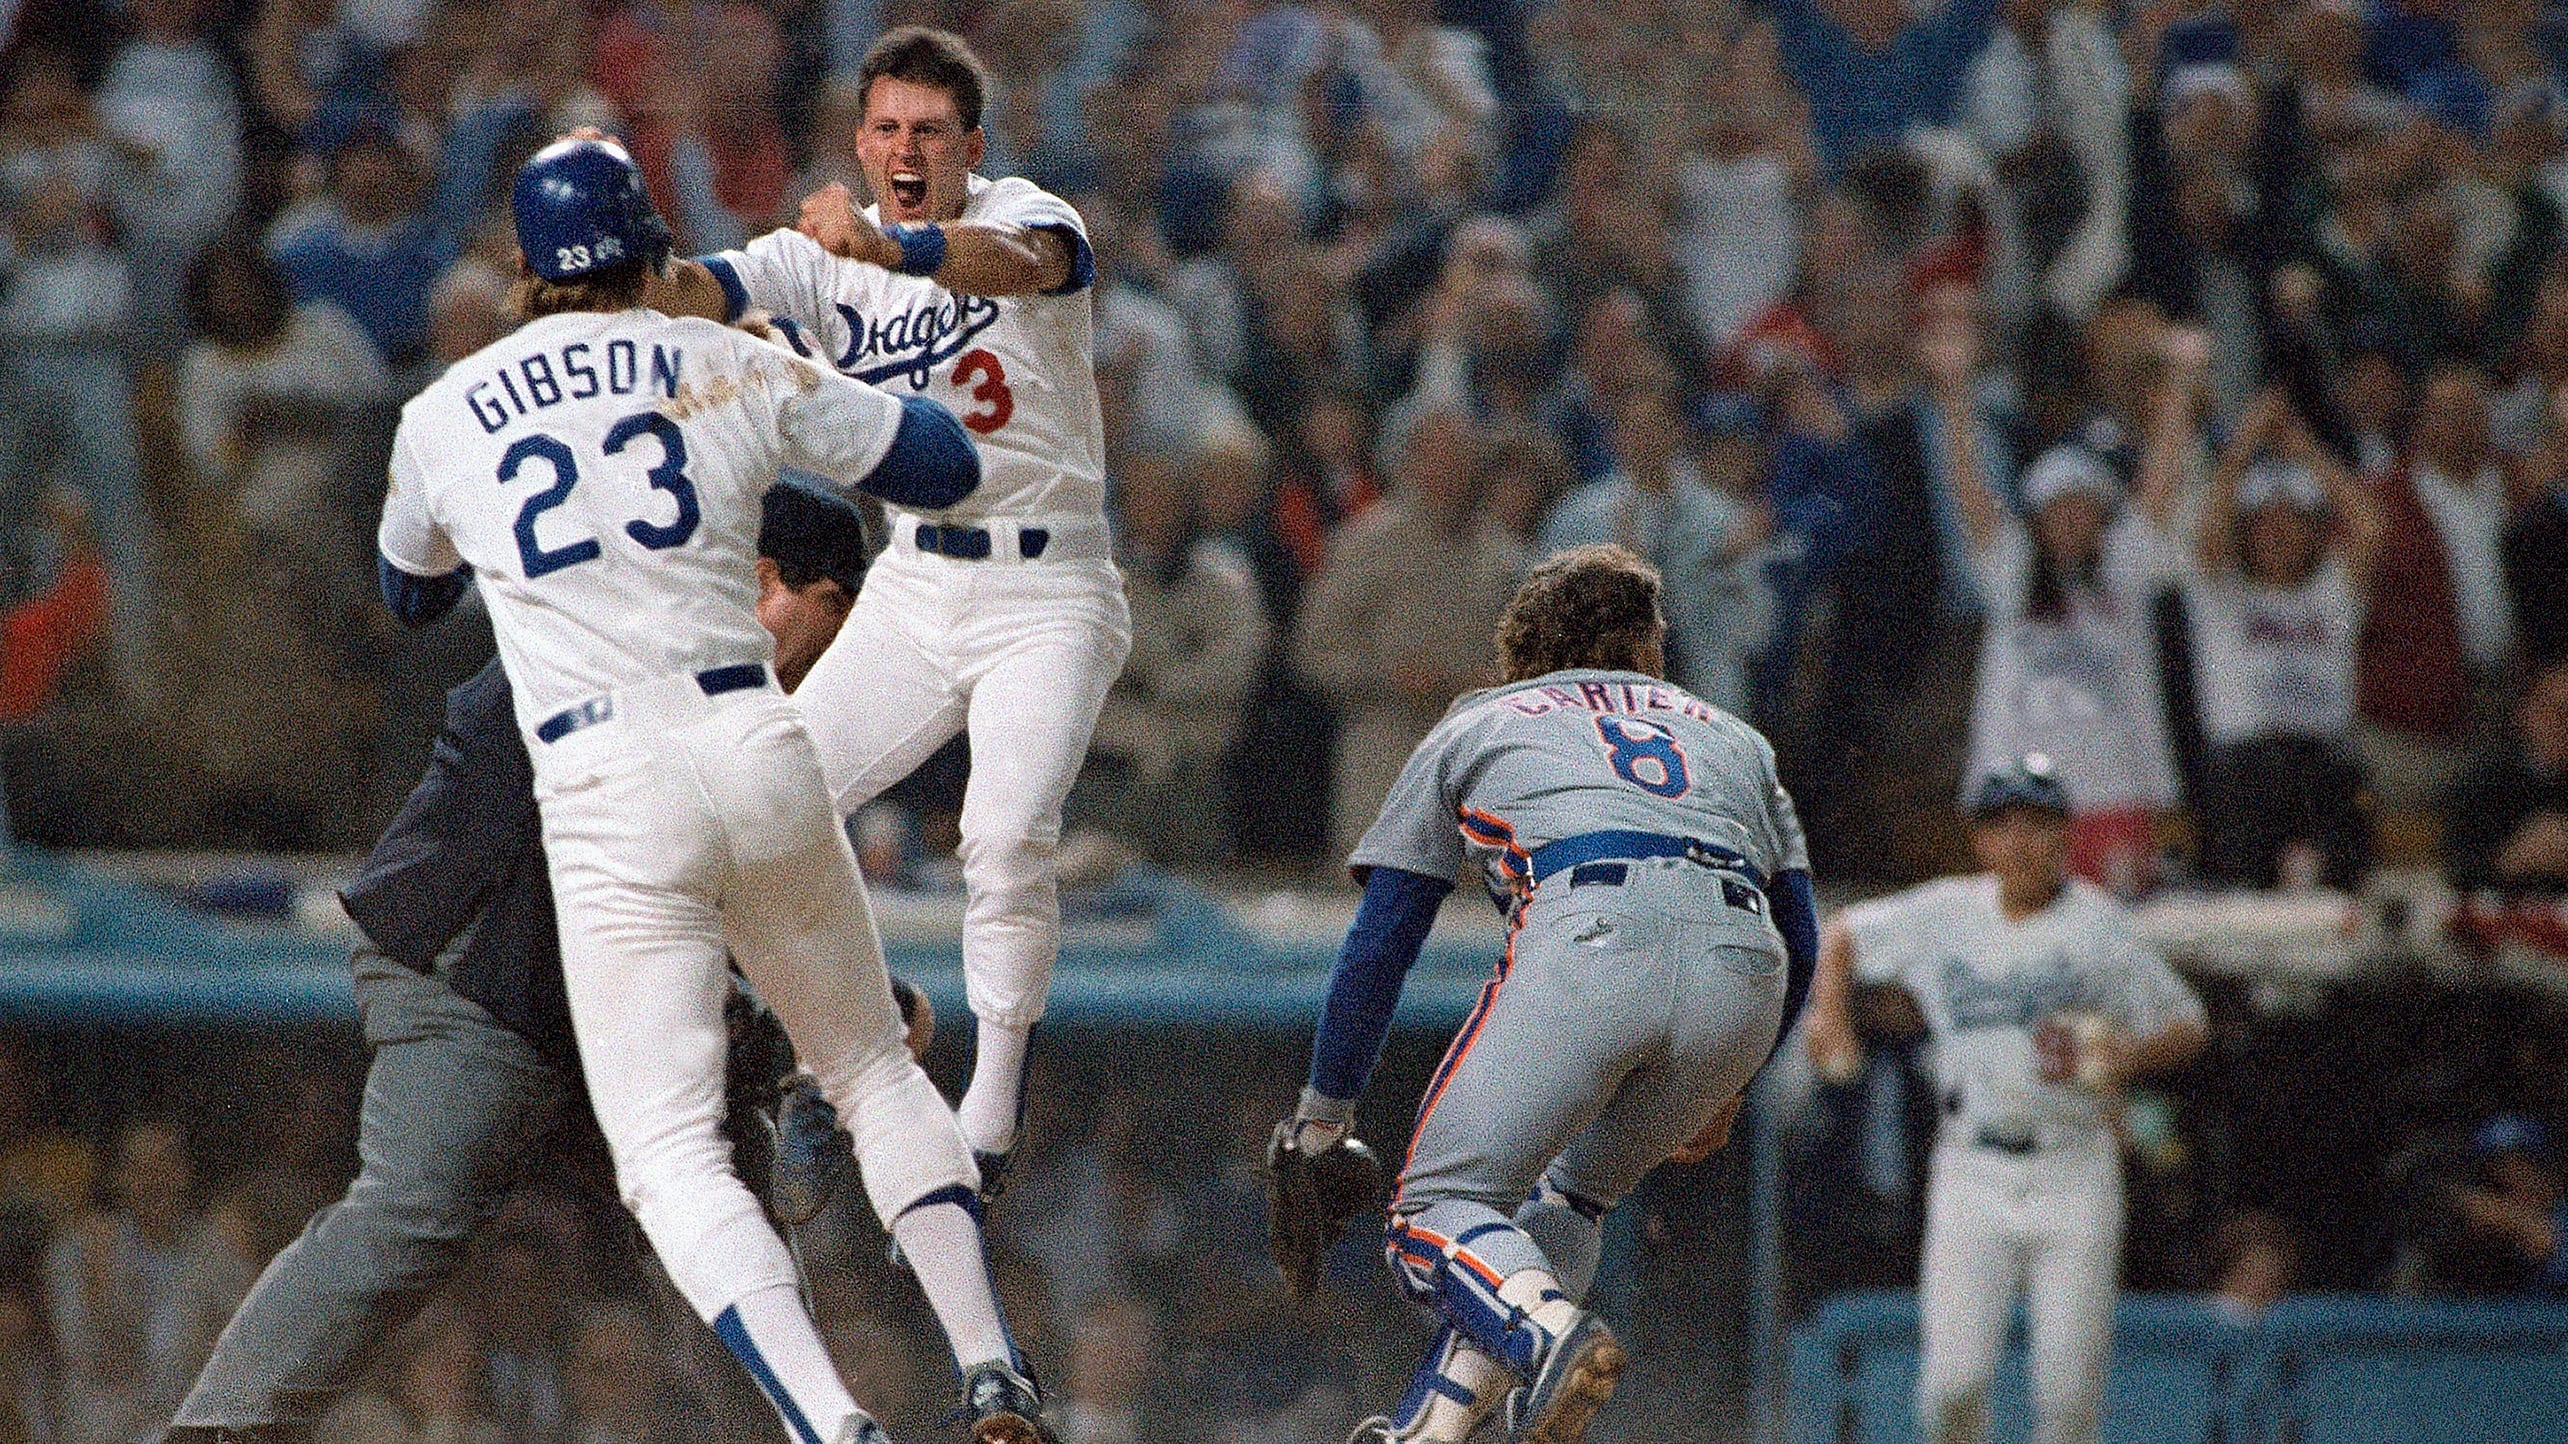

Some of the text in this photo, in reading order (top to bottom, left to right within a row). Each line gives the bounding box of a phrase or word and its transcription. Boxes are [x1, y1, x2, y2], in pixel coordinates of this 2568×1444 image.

[556, 244, 591, 271] 23
[464, 338, 682, 434] GIBSON
[951, 349, 1015, 435] 3
[496, 410, 700, 579] 23
[1594, 714, 1691, 801] 8
